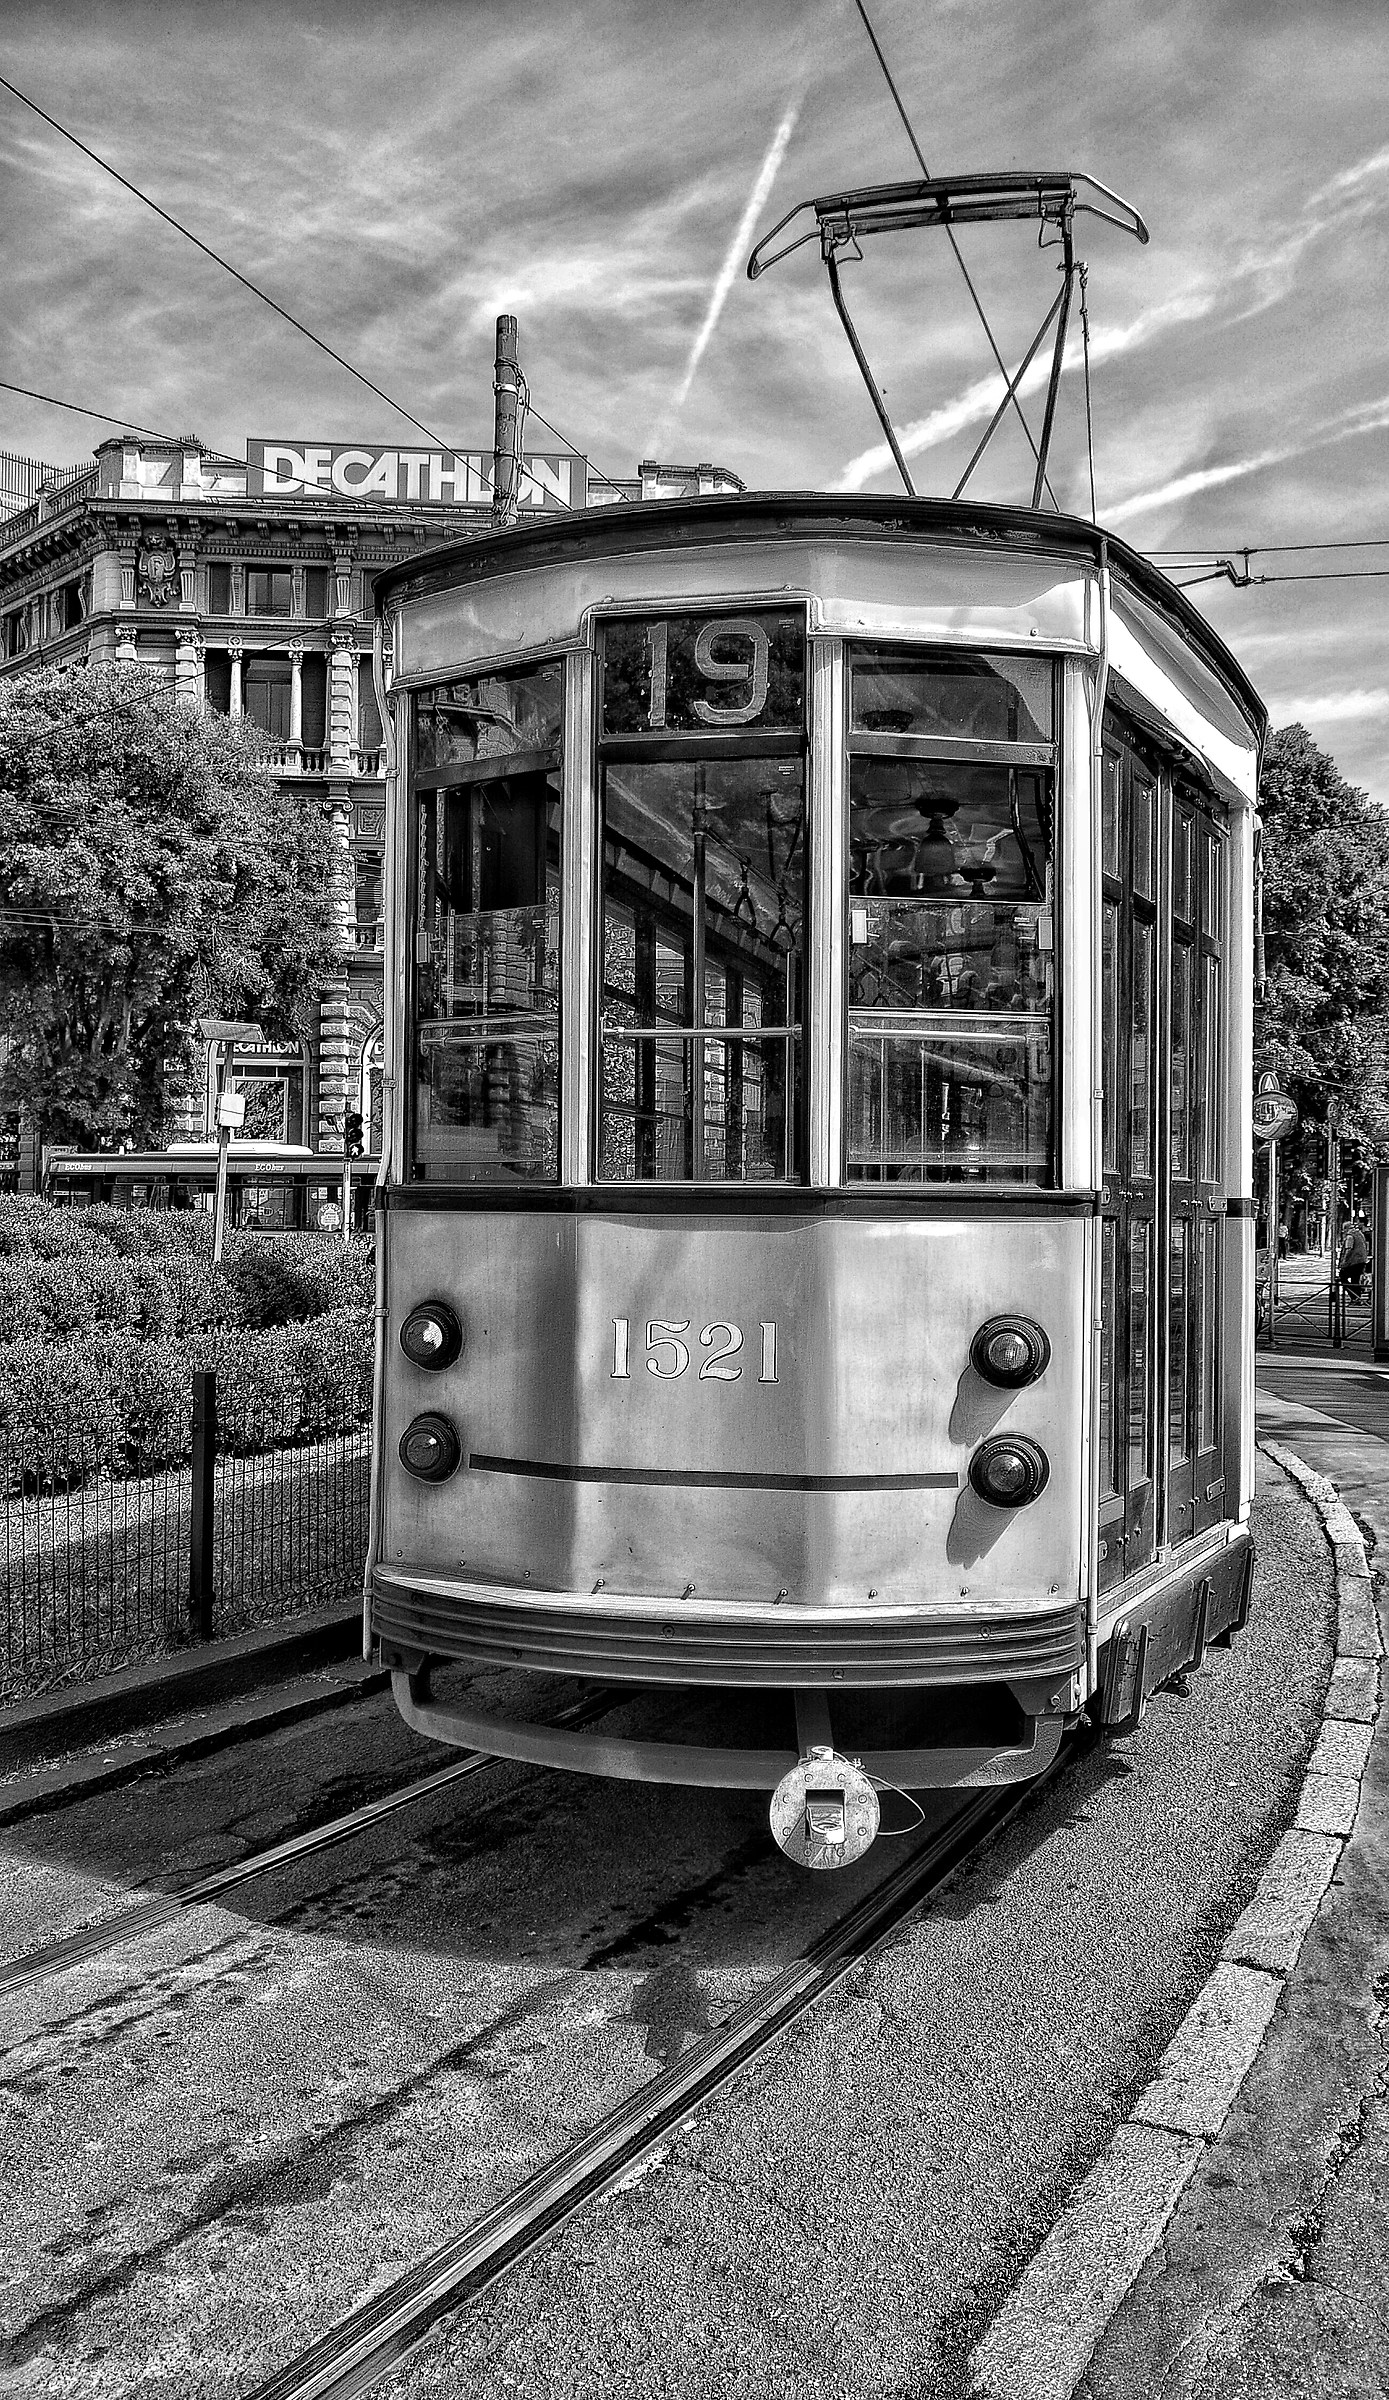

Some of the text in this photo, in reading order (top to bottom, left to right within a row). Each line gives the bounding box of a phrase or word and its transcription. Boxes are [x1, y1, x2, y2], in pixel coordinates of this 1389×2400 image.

[646, 619, 769, 727] 19
[64, 1163, 93, 1171] ECObus
[254, 1163, 285, 1172] ECObus
[610, 1317, 780, 1384] 1521
